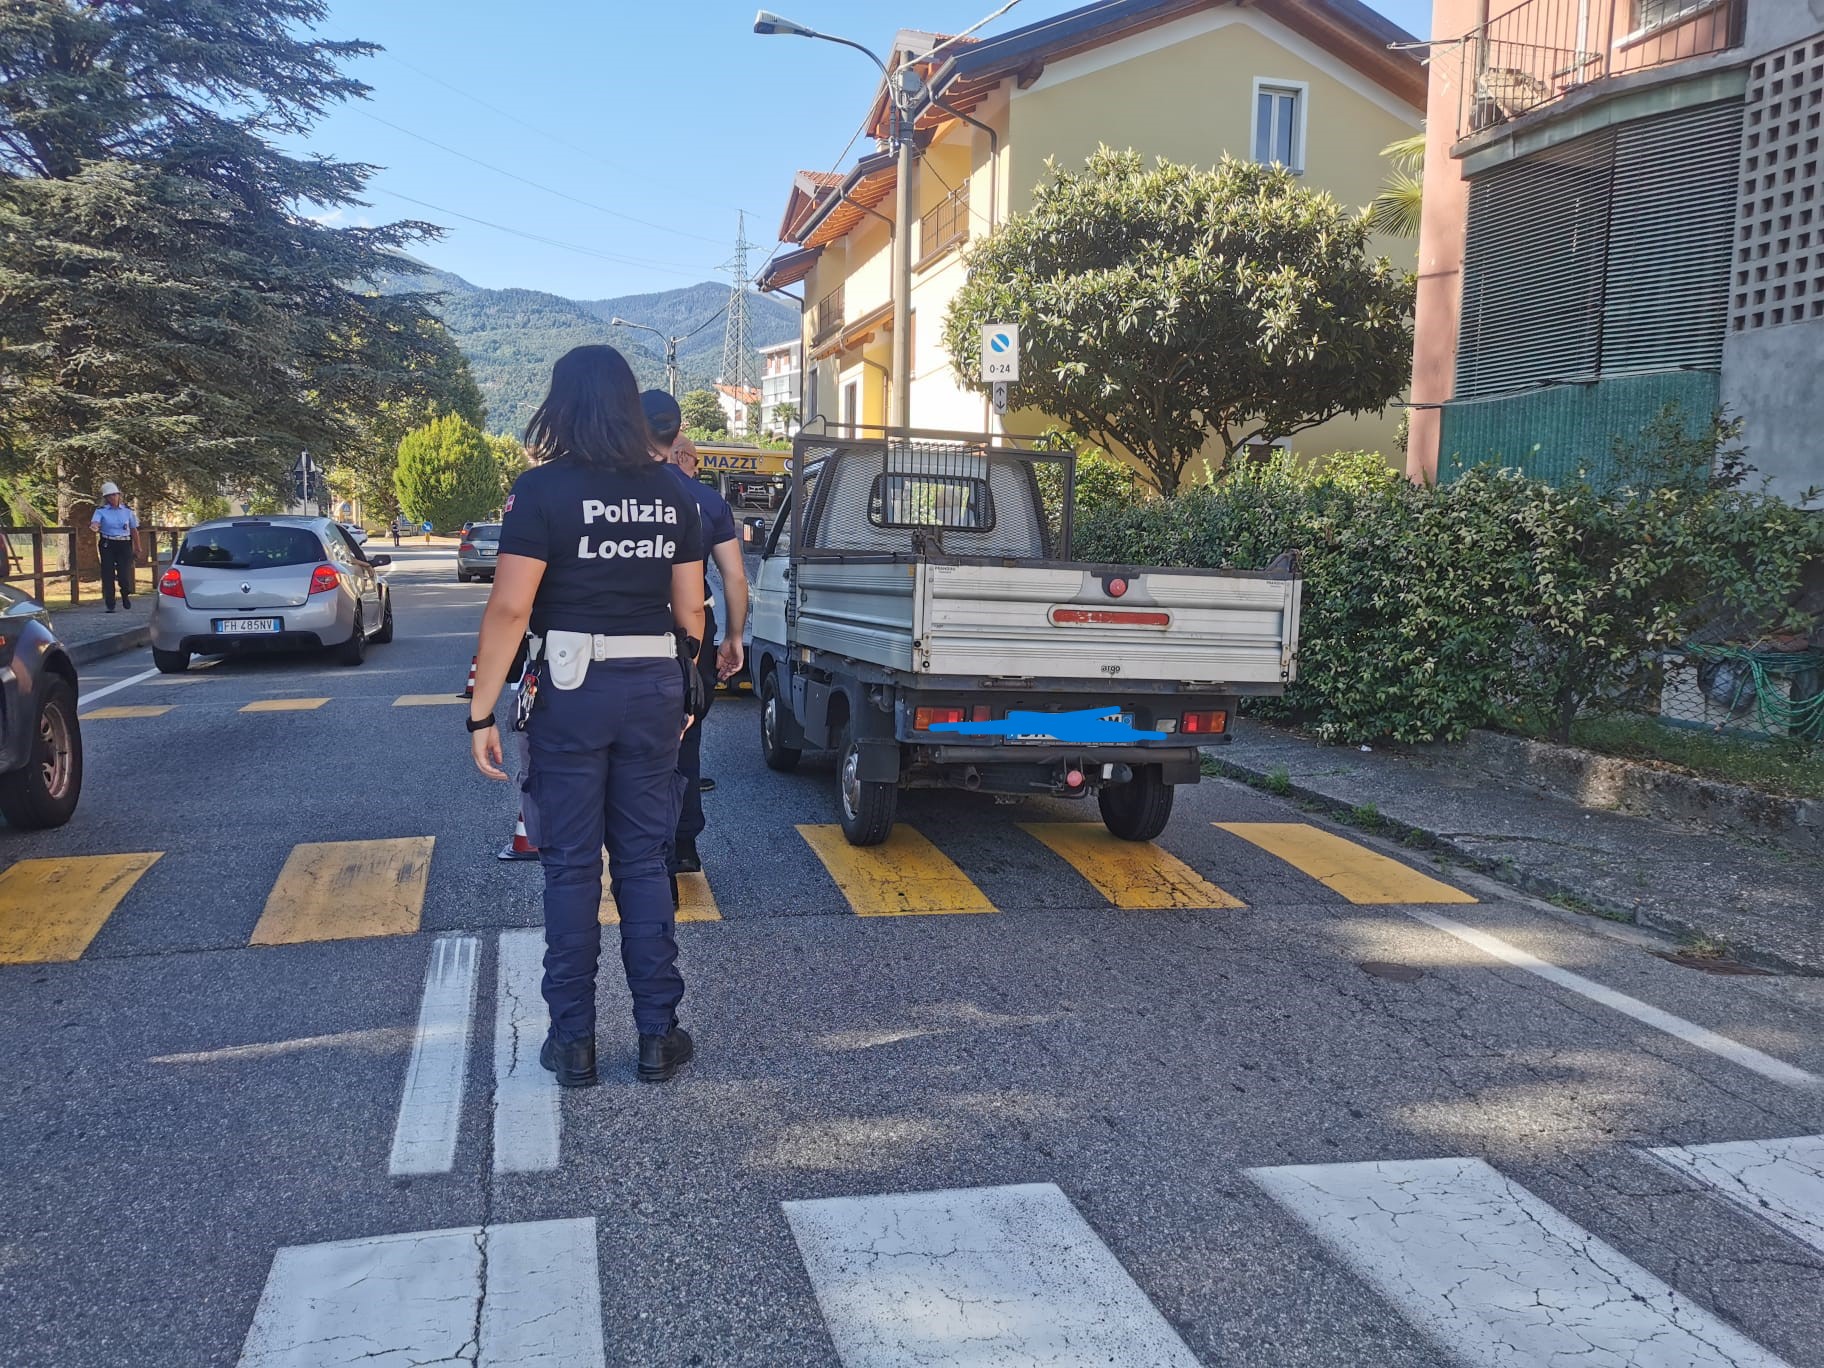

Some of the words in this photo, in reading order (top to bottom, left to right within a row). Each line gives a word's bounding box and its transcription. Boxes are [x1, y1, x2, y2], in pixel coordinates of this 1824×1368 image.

[989, 364, 1011, 373] 0-24
[703, 455, 757, 469] MAZZI
[582, 498, 677, 525] Polizia
[577, 534, 676, 559] Locale
[224, 621, 237, 631] FH
[240, 620, 272, 630] 485NV
